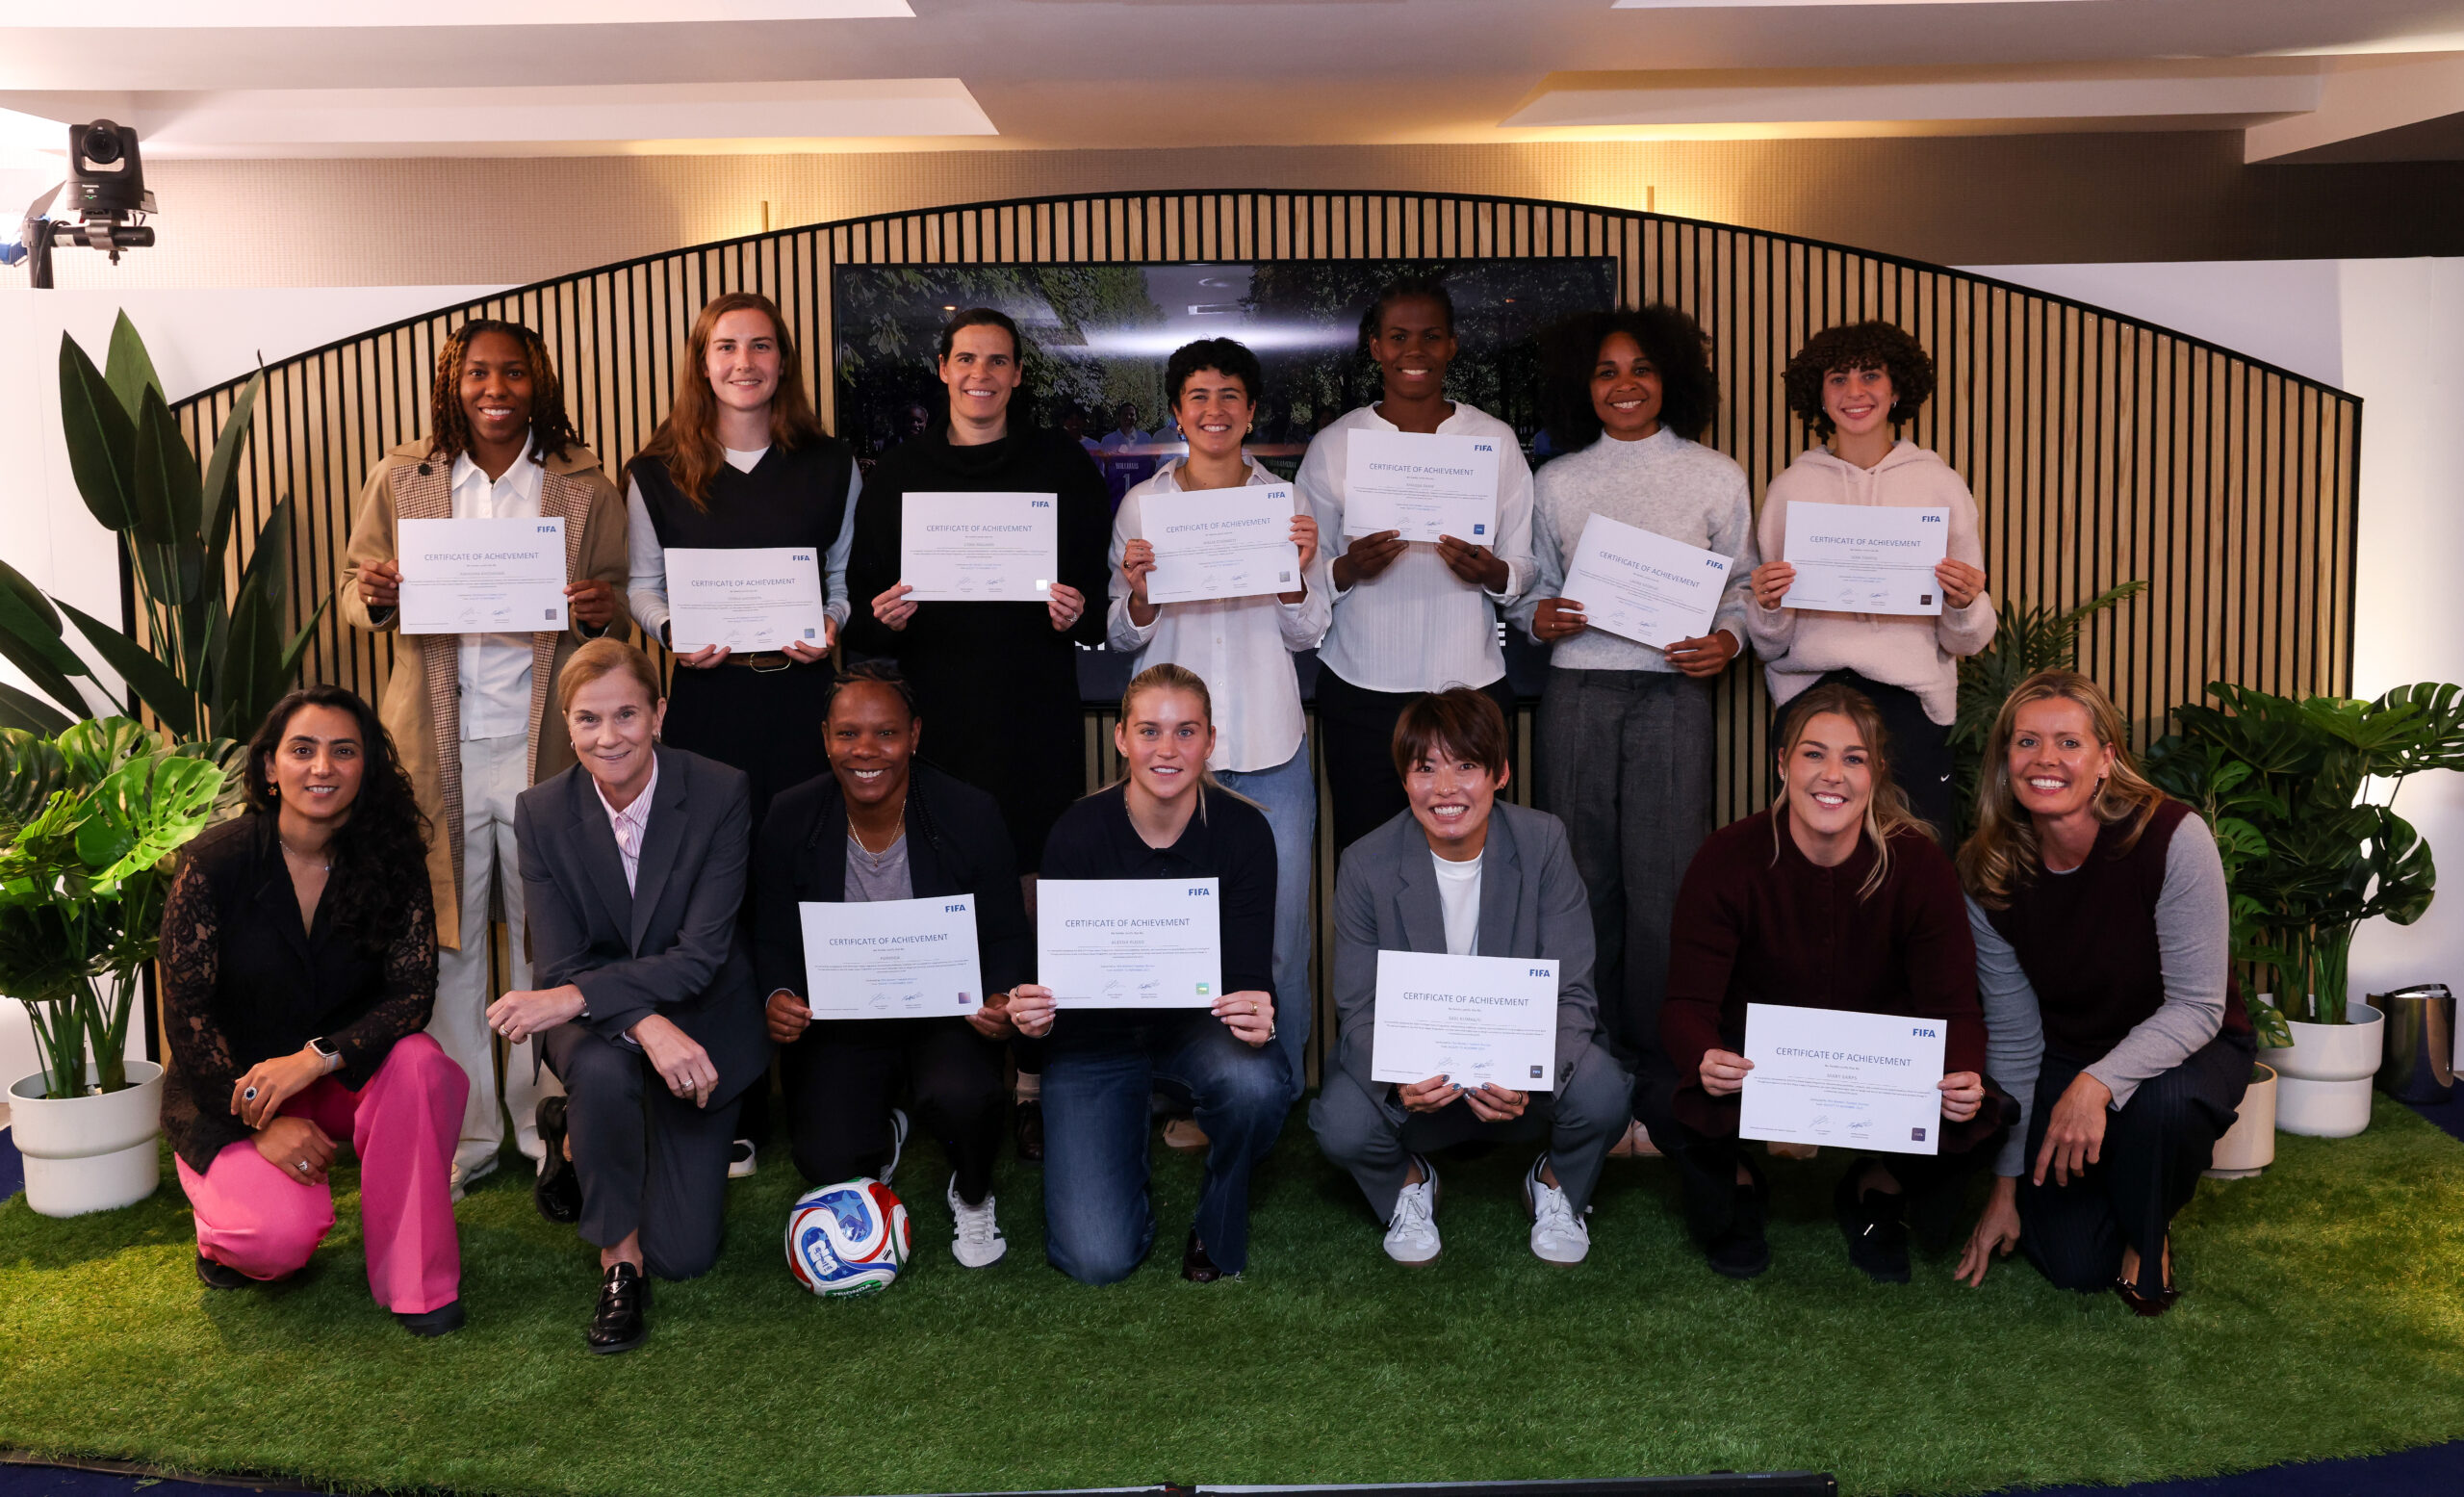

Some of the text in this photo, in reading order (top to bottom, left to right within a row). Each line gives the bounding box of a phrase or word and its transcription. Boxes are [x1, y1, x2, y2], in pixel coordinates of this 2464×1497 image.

[1370, 463, 1411, 473] CERTIFICATE
[1424, 467, 1474, 476] ACHIEVEMENT
[1167, 524, 1208, 533] CERTIFICATE
[1221, 518, 1270, 528] ACHIEVEMENT
[1600, 552, 1639, 569] CERTIFICATE
[1652, 569, 1700, 588] ACHIEVEMENT
[1707, 559, 1723, 570] FIFA
[892, 934, 948, 943] ACHIEVEMENT
[1403, 993, 1453, 1003] CERTIFICATE
[1470, 996, 1528, 1006] ACHIEVEMENT
[1912, 1028, 1936, 1038] FIFA
[1776, 1047, 1830, 1060] CERTIFICATE
[1847, 1053, 1912, 1067] ACHIEVEMENT
